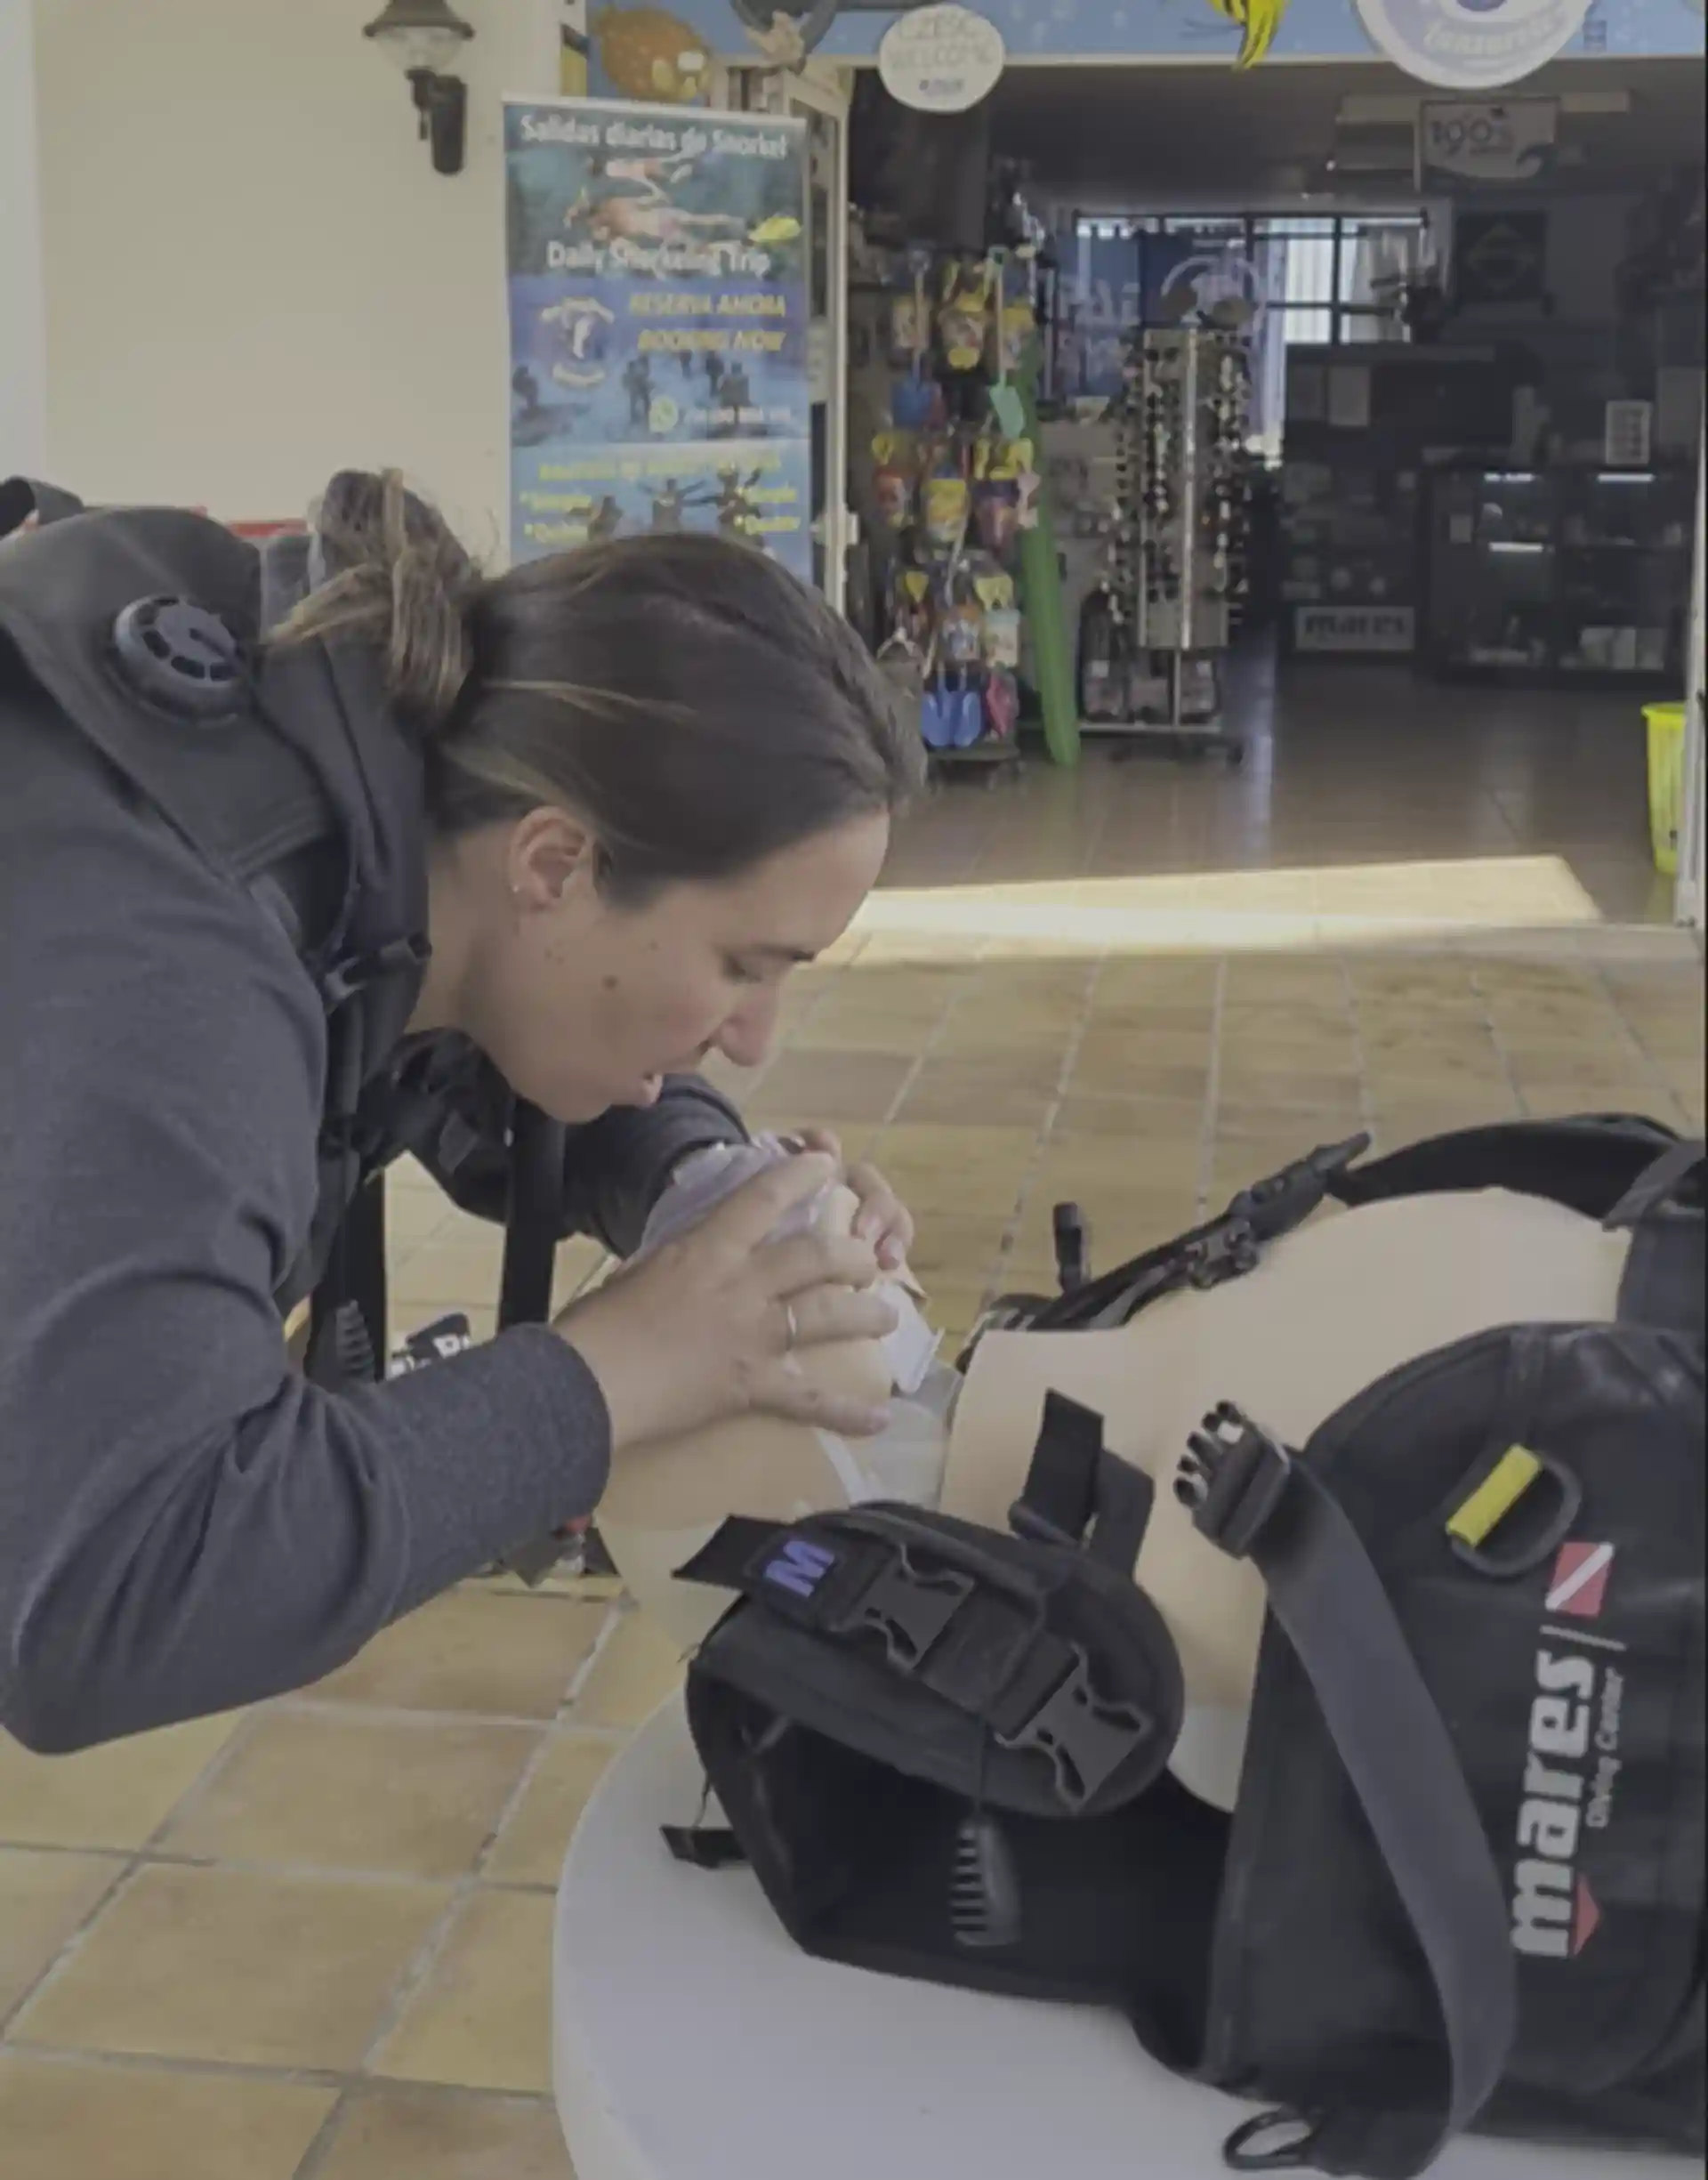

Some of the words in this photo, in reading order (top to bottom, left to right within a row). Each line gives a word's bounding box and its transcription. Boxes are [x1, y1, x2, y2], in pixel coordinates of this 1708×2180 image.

[1595, 1666, 1625, 1751] Center
[1511, 1650, 1595, 1958] mares
[1586, 1756, 1622, 1829] Diving
